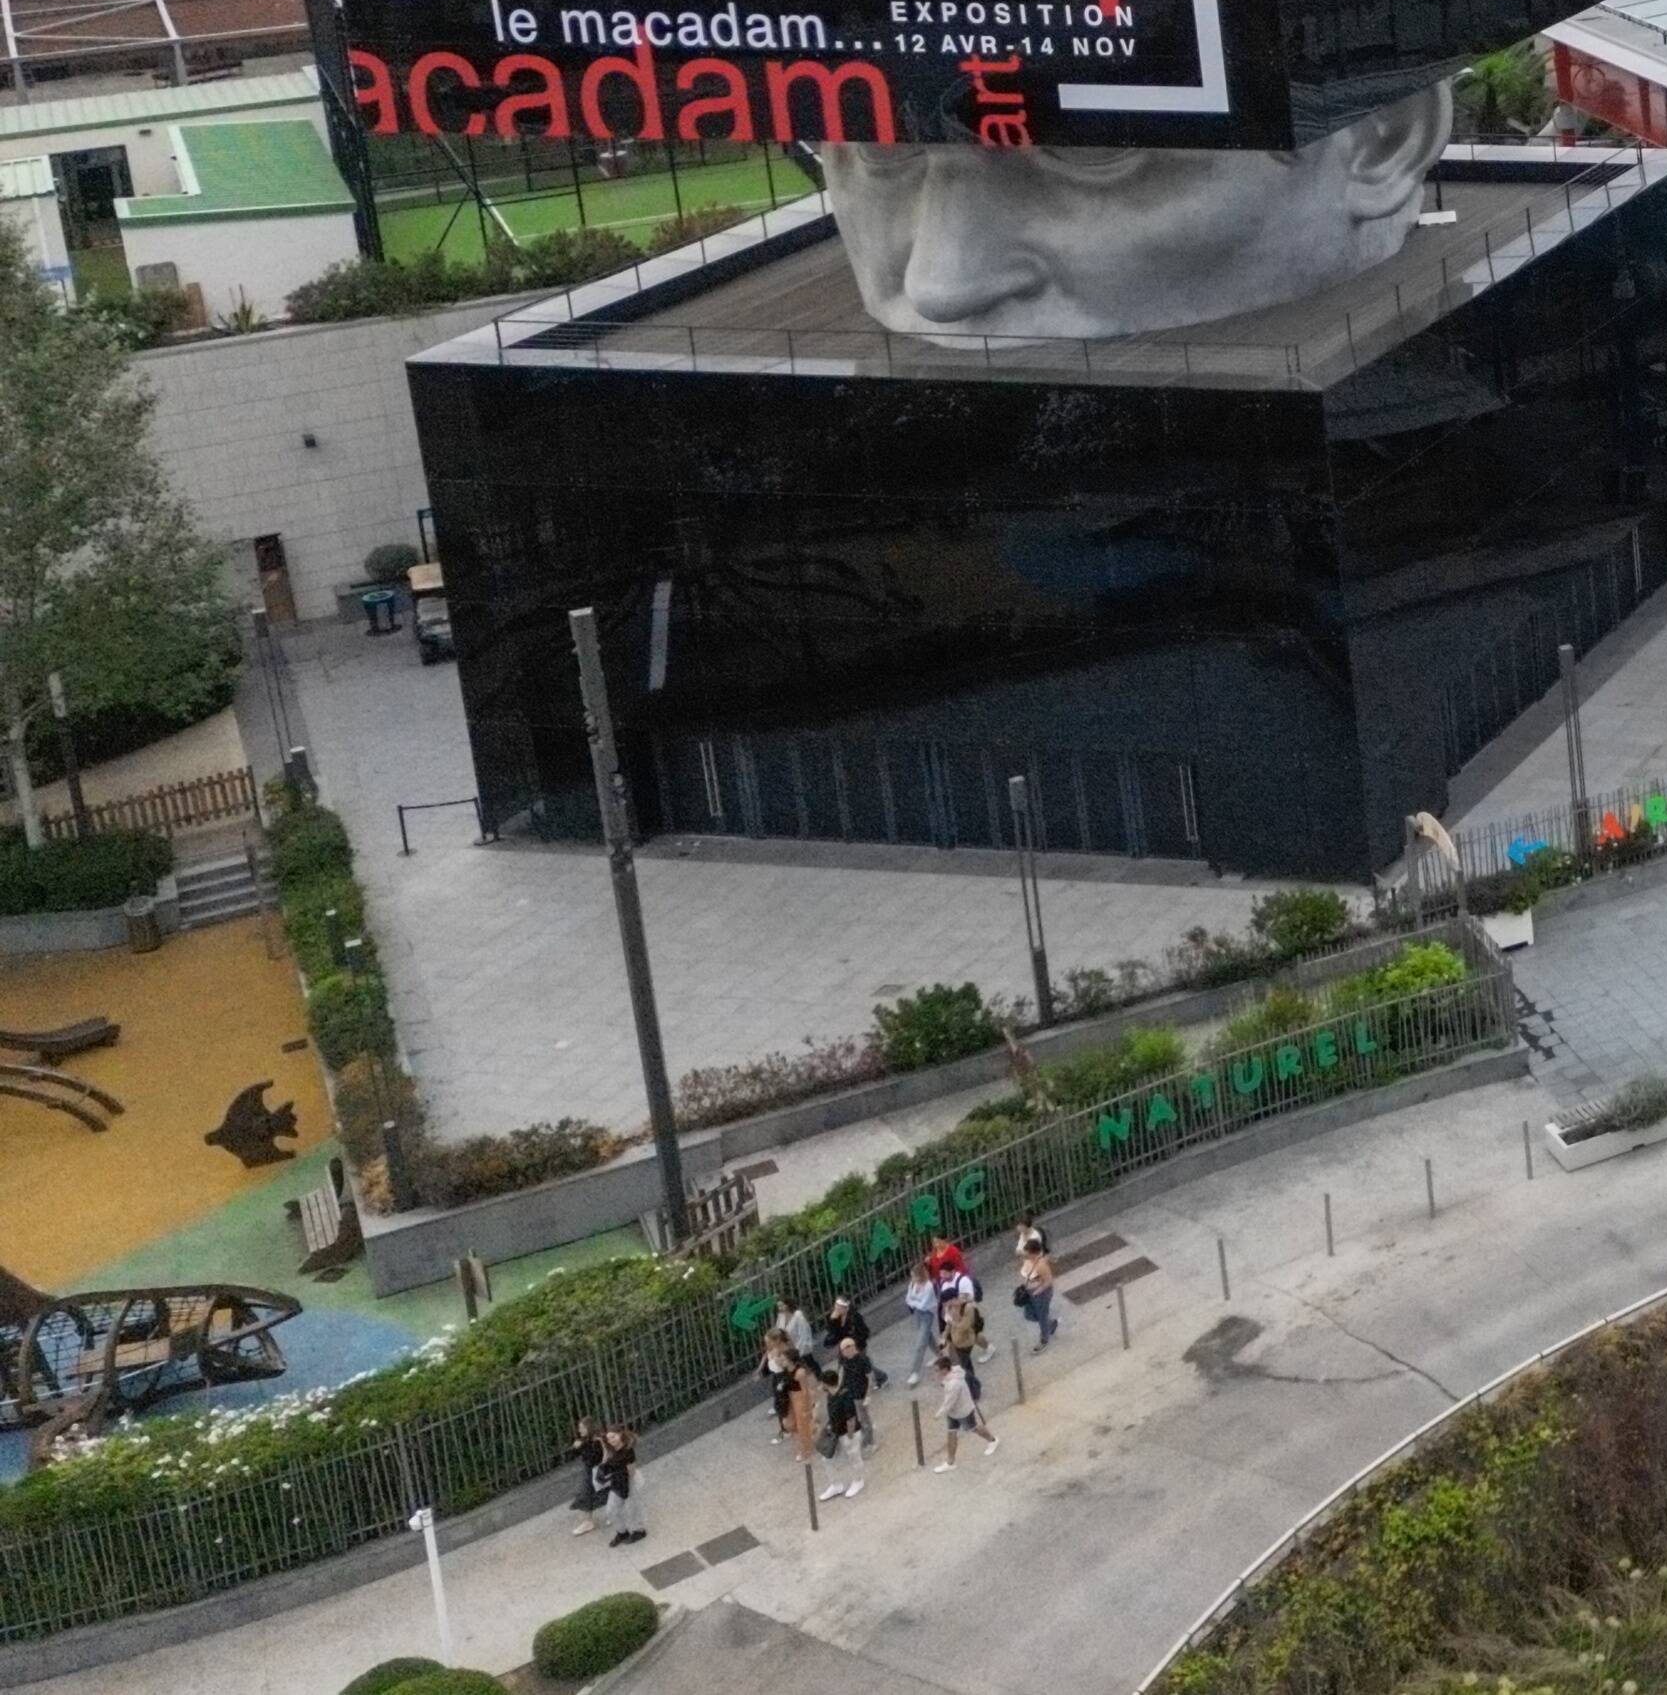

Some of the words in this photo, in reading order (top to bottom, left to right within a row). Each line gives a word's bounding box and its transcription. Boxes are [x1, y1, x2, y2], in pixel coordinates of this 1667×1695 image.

[890, 1, 1133, 28] EXPOSITION
[895, 33, 926, 54] 12
[1072, 36, 1136, 56] NOV
[960, 53, 1033, 147] art
[827, 1169, 985, 1285] PARC
[1096, 1021, 1376, 1149] NATUREL
